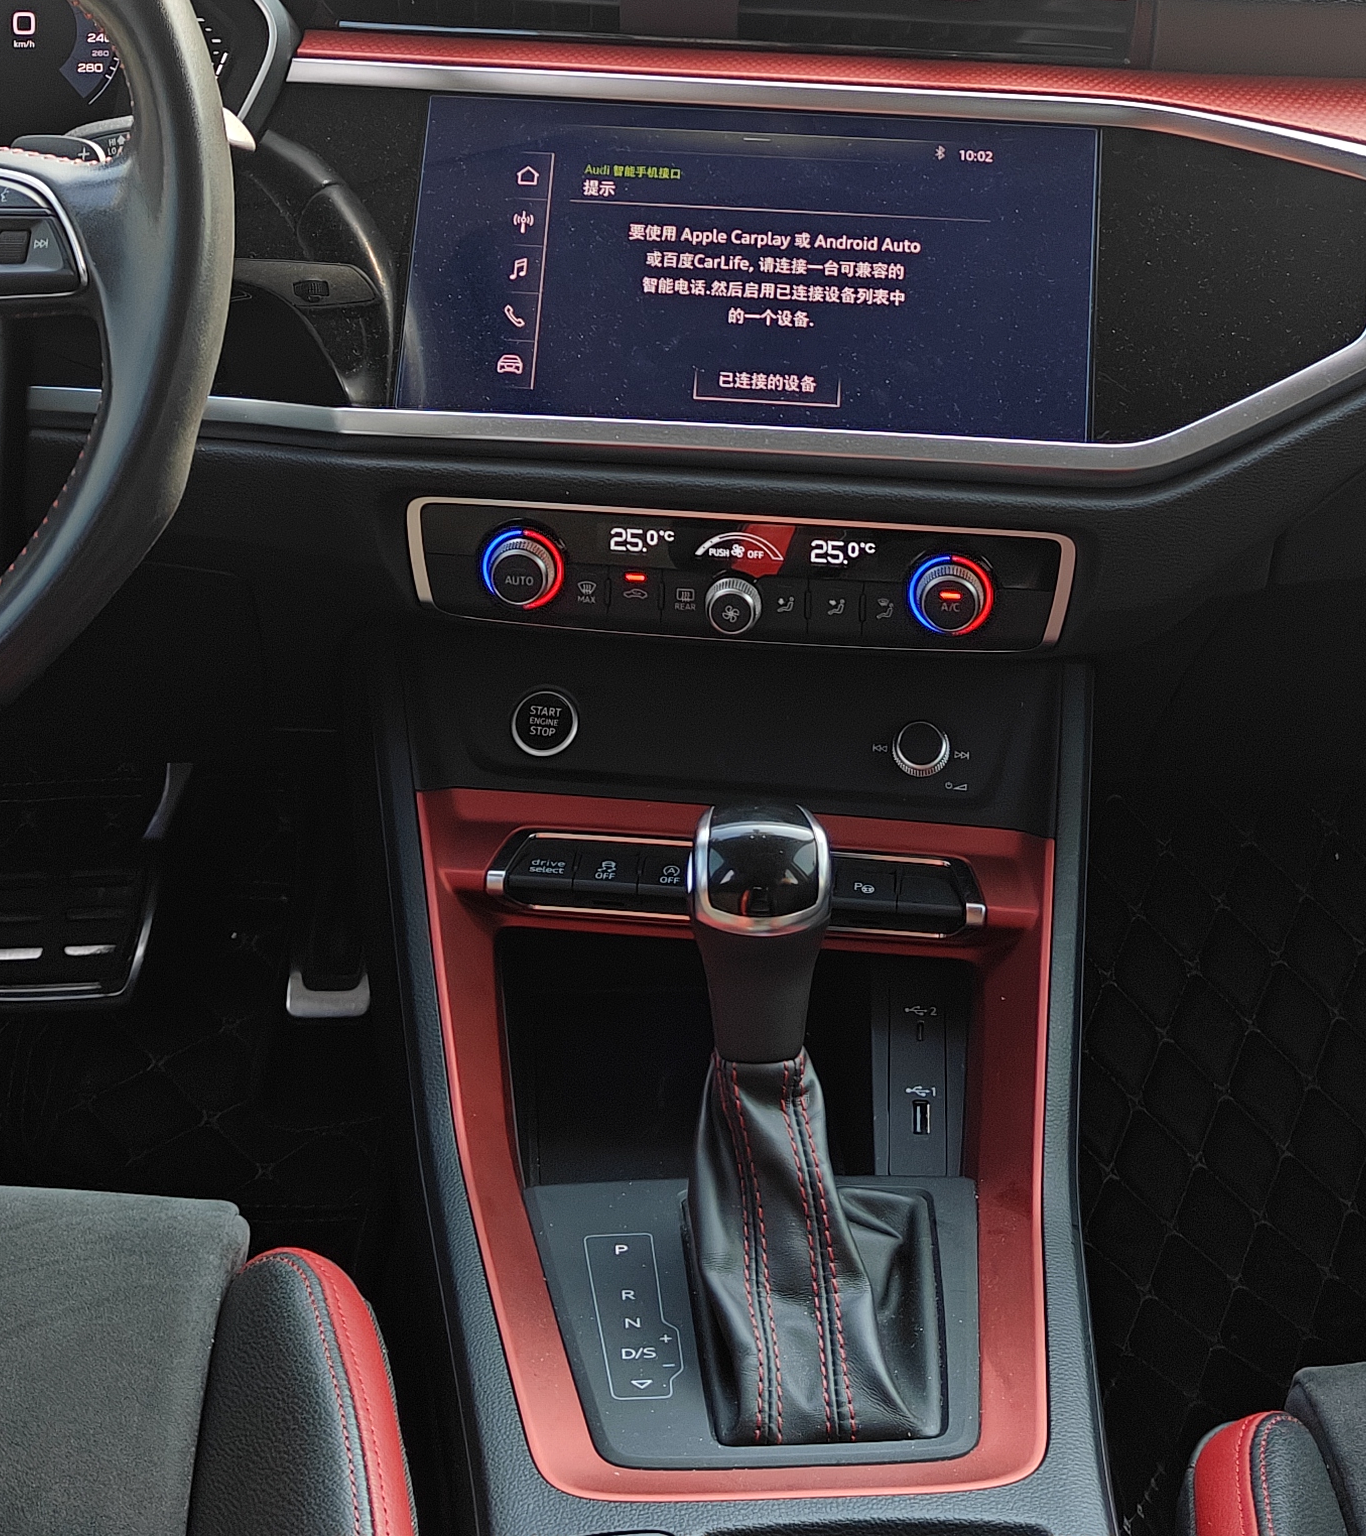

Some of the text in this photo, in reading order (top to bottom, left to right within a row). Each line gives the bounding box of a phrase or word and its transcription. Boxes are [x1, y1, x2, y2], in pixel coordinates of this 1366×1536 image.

[12, 11, 36, 35] 0
[13, 40, 36, 49] km/h
[77, 63, 103, 73] 280
[108, 138, 117, 146] HI
[107, 147, 117, 156] LO
[958, 147, 994, 163] 10:02
[584, 164, 682, 180] Audi 智能手机接口
[582, 179, 616, 197] 提示
[628, 223, 921, 254] 要使用 Apple Carplay 或 Android Auto
[646, 250, 905, 280] 或百度CarLife, 请连接一台可兼容的
[642, 276, 906, 307] 智能电话.然后启用已连接设备列表中
[727, 307, 815, 329] 的一个设备.
[718, 371, 817, 393] 已连接的设备
[708, 547, 765, 560] PUSH OFF
[504, 575, 534, 586] AUTO
[577, 595, 597, 604] MAX
[674, 602, 696, 611] REAR
[941, 603, 961, 612] A/C
[529, 705, 562, 717] START
[529, 716, 559, 726] ENGINE
[529, 726, 556, 736] STOP
[531, 859, 566, 867] drive
[529, 866, 565, 874] select
[594, 872, 616, 880] OFF
[659, 876, 681, 884] OFF
[929, 1007, 937, 1016] 2
[614, 1244, 629, 1255] P
[621, 1289, 636, 1300] R
[625, 1317, 641, 1328] N
[620, 1347, 657, 1360] D/S
